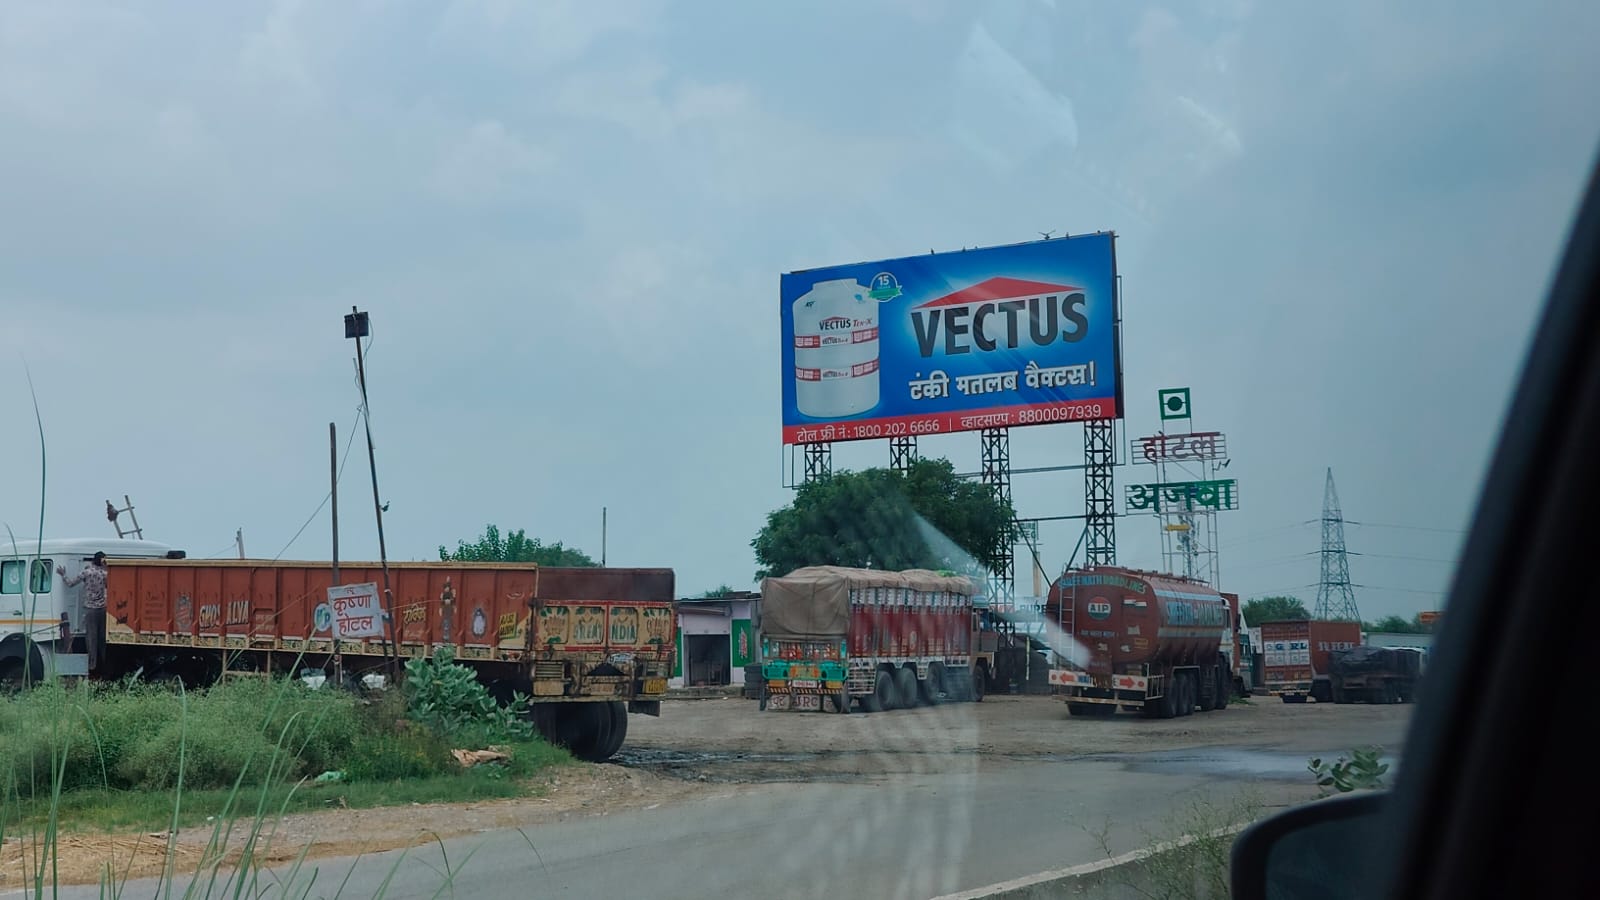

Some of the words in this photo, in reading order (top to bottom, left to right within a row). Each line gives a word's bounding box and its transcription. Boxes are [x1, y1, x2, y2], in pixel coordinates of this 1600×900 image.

[879, 275, 890, 286] 15
[819, 318, 851, 331] VECTUS
[911, 292, 1089, 358] VECTUS
[908, 371, 950, 400] टंकी
[955, 370, 1019, 396] मतलब
[1018, 404, 1102, 424] 8800097939
[796, 427, 817, 443] टोल
[819, 425, 836, 440] फ्री
[853, 424, 881, 438] 1800
[884, 422, 906, 436] 202
[909, 419, 940, 433] 6666
[1139, 430, 1221, 464] होटल
[336, 614, 374, 636] होटल
